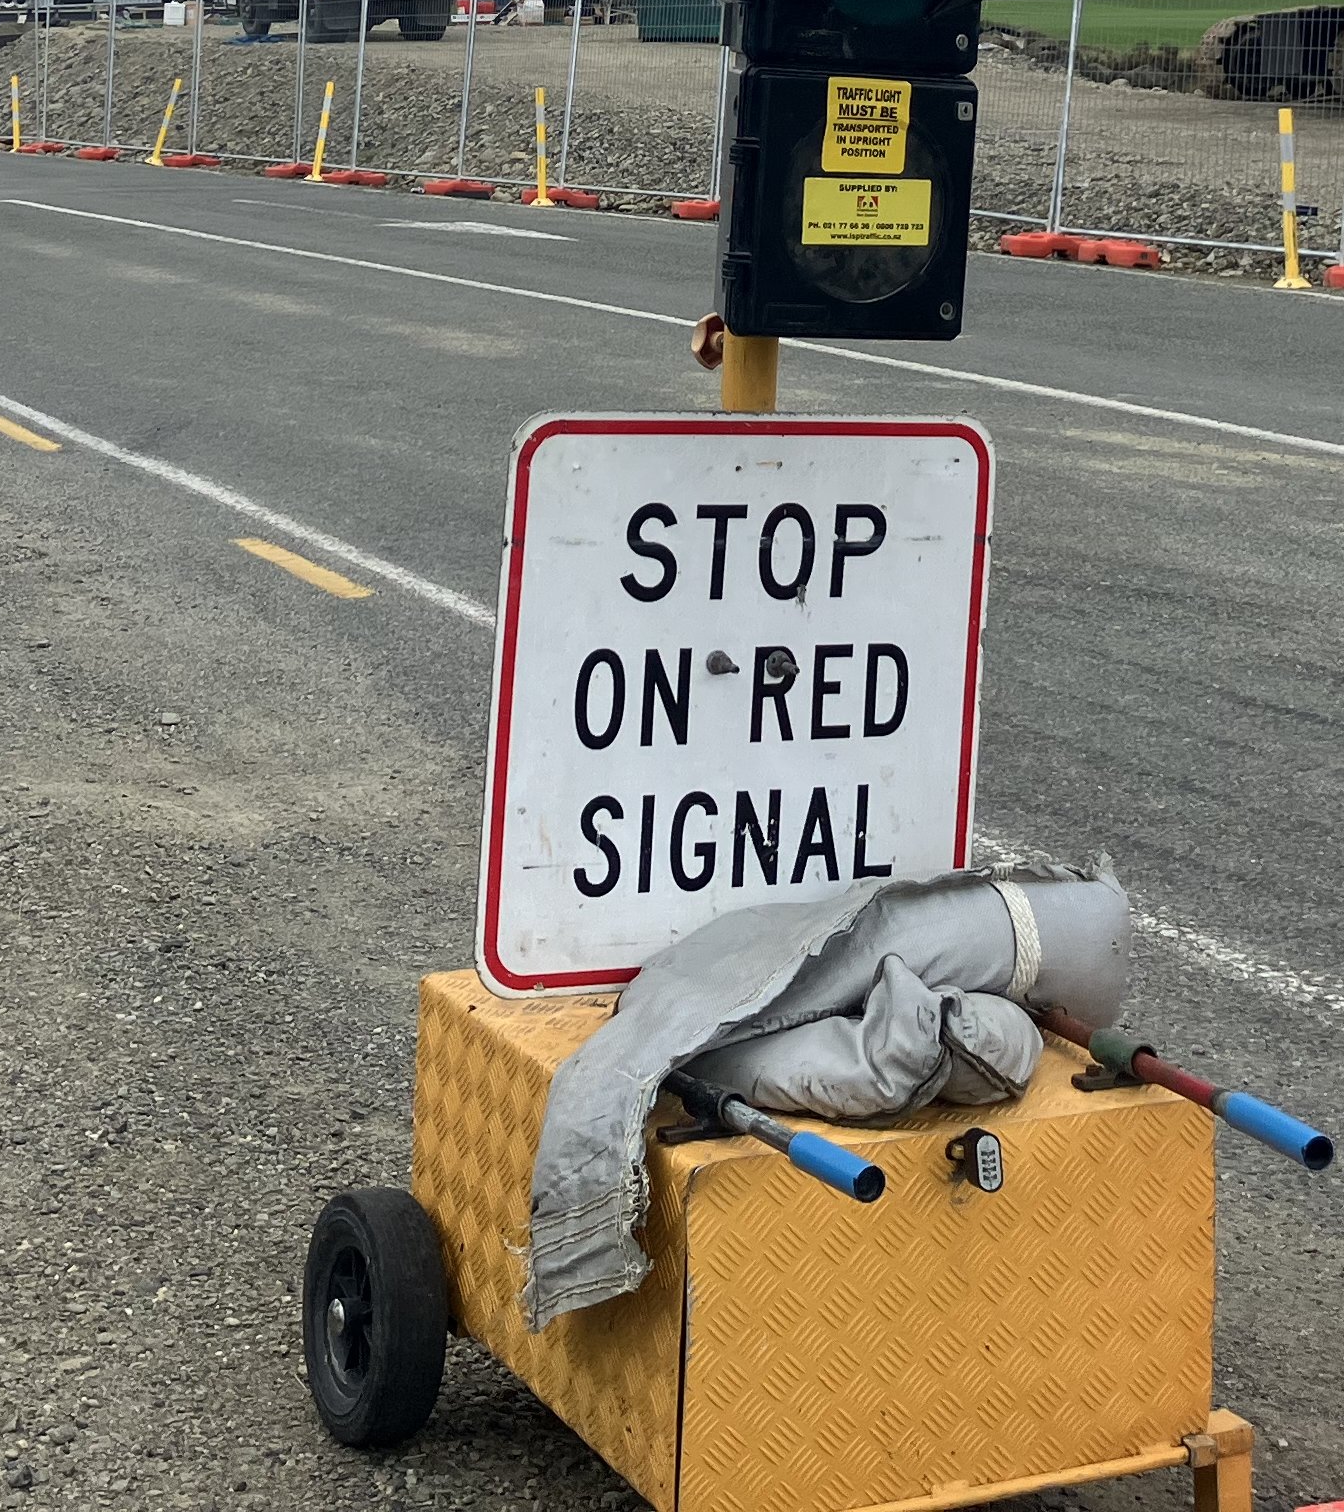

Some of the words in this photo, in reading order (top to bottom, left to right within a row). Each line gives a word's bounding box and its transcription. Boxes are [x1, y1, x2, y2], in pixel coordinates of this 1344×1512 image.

[837, 86, 874, 102] TRAFFIC
[875, 88, 902, 104] LIGHT
[838, 103, 877, 118] MUST
[879, 106, 898, 120] BE
[832, 123, 899, 135] TRANSPORTED
[836, 135, 847, 144] IN
[849, 135, 892, 147] UPRIGHT
[840, 147, 886, 159] POSITION
[839, 184, 882, 192] SUPPLIED
[620, 502, 887, 602] STOP
[574, 647, 693, 750] ON
[750, 643, 910, 743] RED
[573, 784, 896, 898] SIGNAL
